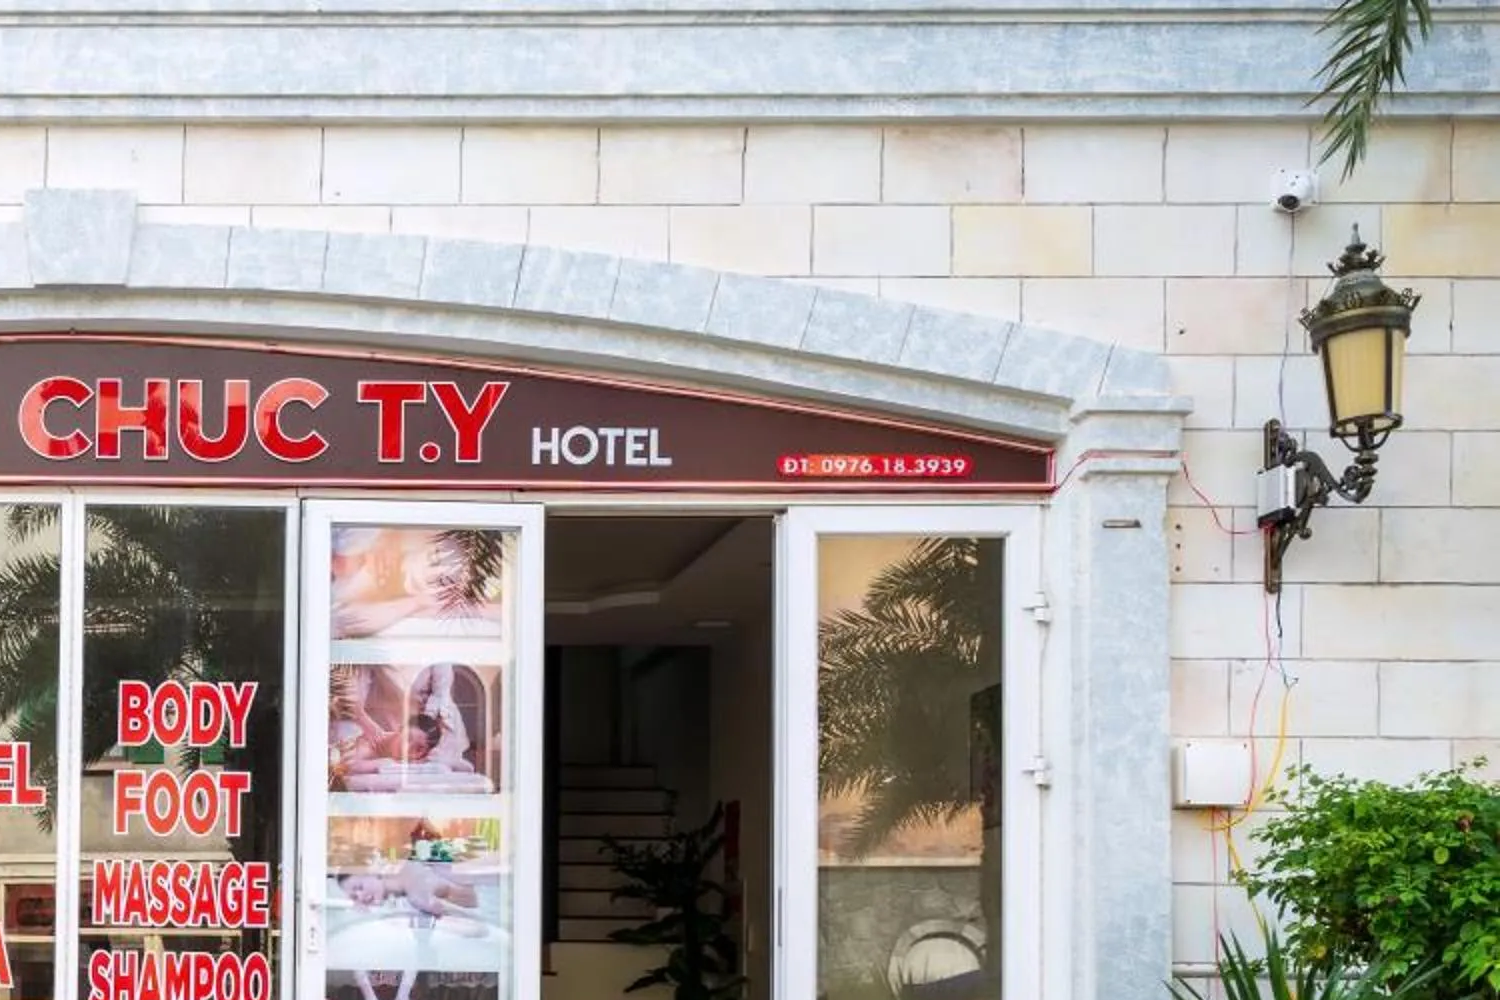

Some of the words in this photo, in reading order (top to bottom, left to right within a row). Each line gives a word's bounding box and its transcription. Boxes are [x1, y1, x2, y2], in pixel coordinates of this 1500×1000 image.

[18, 376, 329, 461] CHUC
[357, 381, 509, 463] T.Y
[532, 426, 672, 467] HOTEL
[821, 459, 966, 473] 0976.18.3939
[117, 680, 258, 747] BODY
[113, 771, 250, 836] FOOT
[92, 861, 270, 928] MASSAGE
